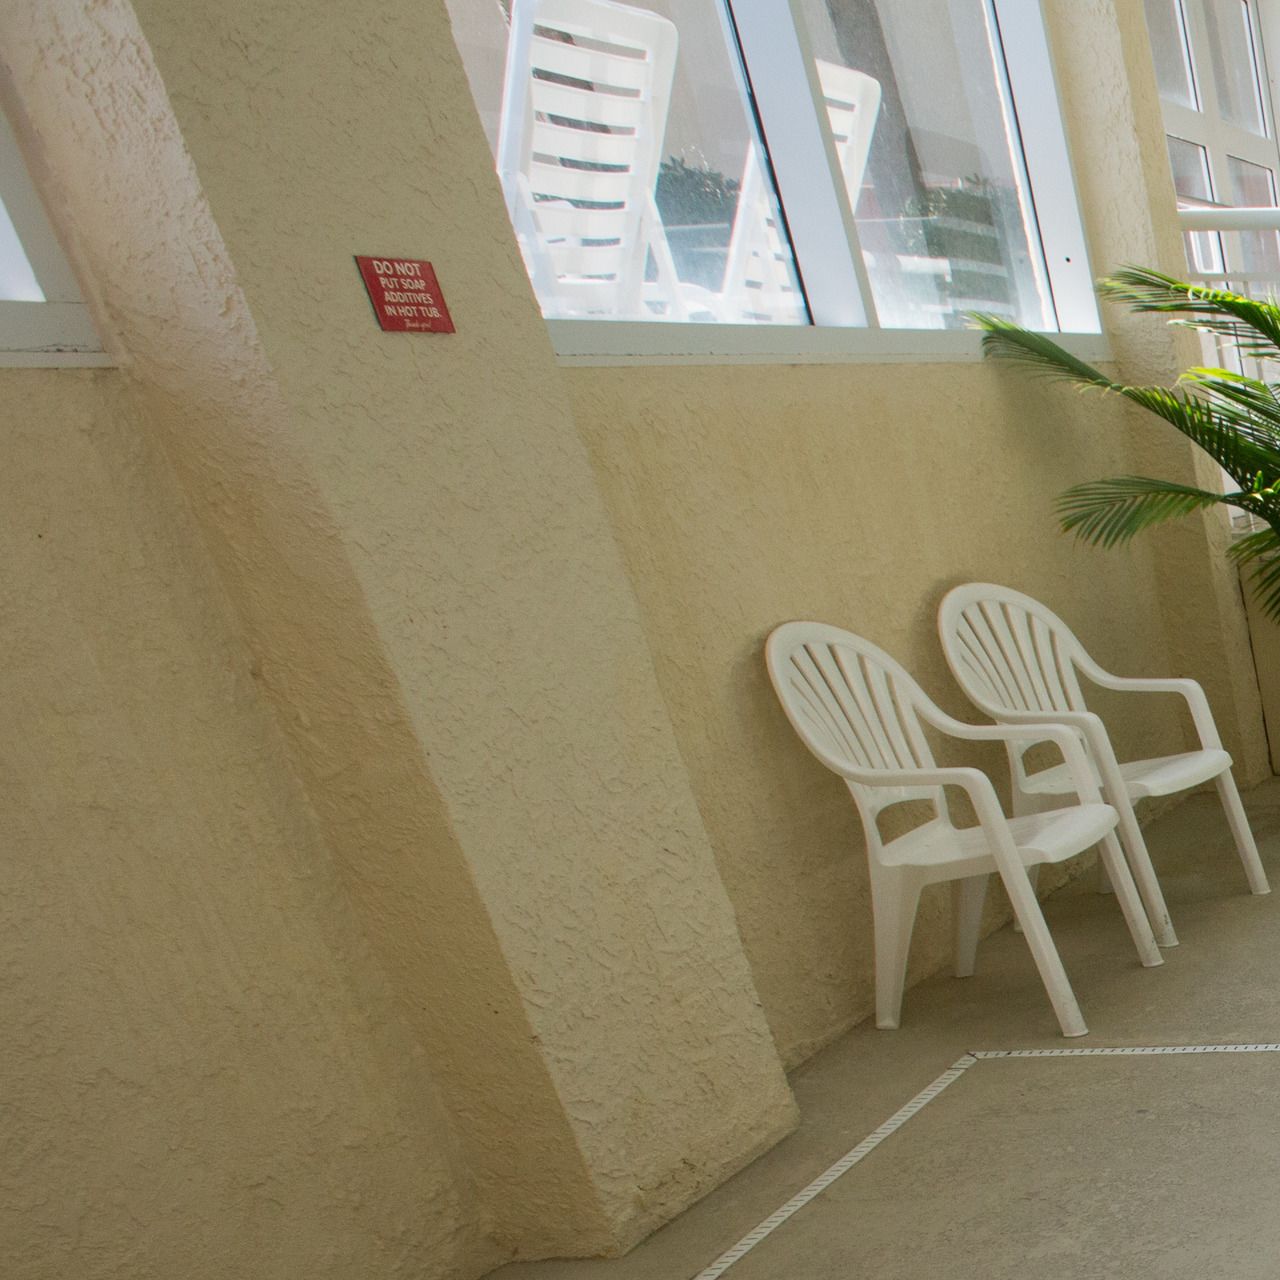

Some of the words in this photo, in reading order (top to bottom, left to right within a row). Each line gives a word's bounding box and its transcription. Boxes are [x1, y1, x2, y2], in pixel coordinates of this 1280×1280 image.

[372, 260, 393, 275] DO
[395, 262, 421, 277] NOT
[379, 277, 400, 289] PUT
[401, 279, 426, 290] SOAP
[384, 291, 434, 304] ADDITIVES
[384, 305, 397, 316] IN
[396, 306, 418, 317] HOT
